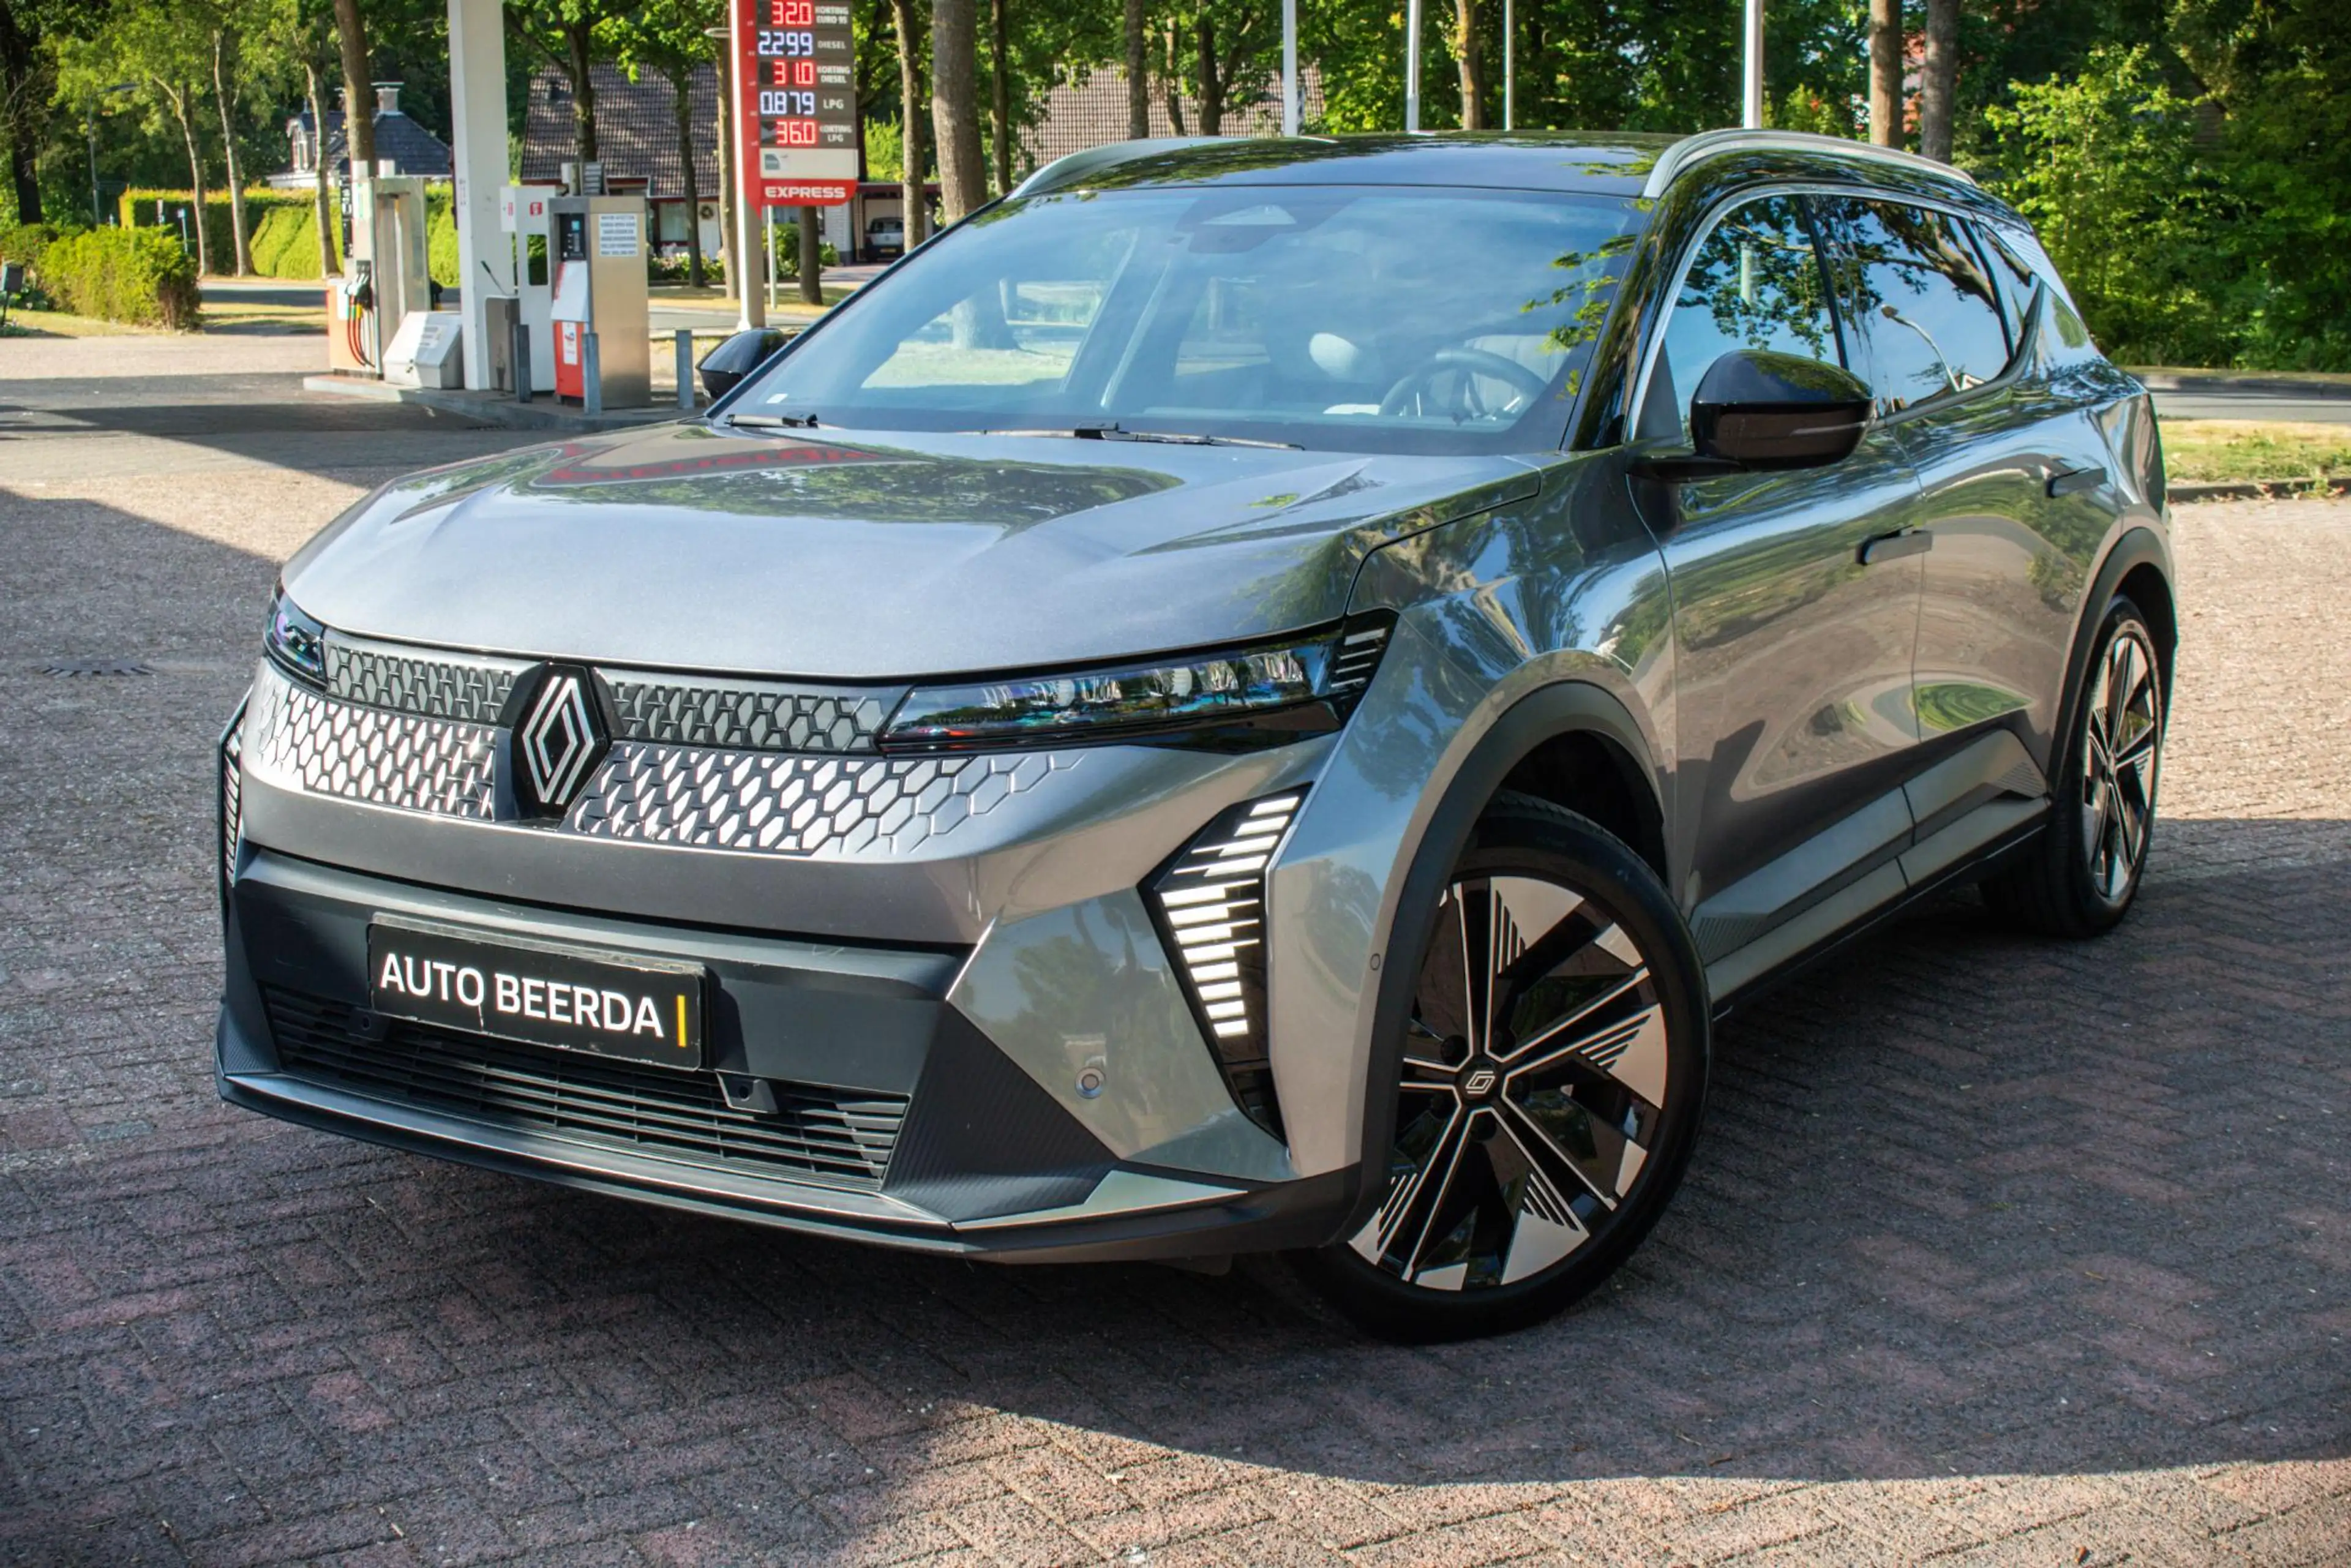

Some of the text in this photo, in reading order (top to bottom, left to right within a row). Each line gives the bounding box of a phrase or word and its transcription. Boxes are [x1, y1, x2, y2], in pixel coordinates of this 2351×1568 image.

[816, 15, 837, 24] EURO
[817, 40, 846, 50] DIESEL
[821, 75, 847, 84] DIESEL
[823, 99, 844, 110] LPG
[765, 186, 846, 198] EXPRESS
[380, 953, 664, 1038] AUTO BEERDA
